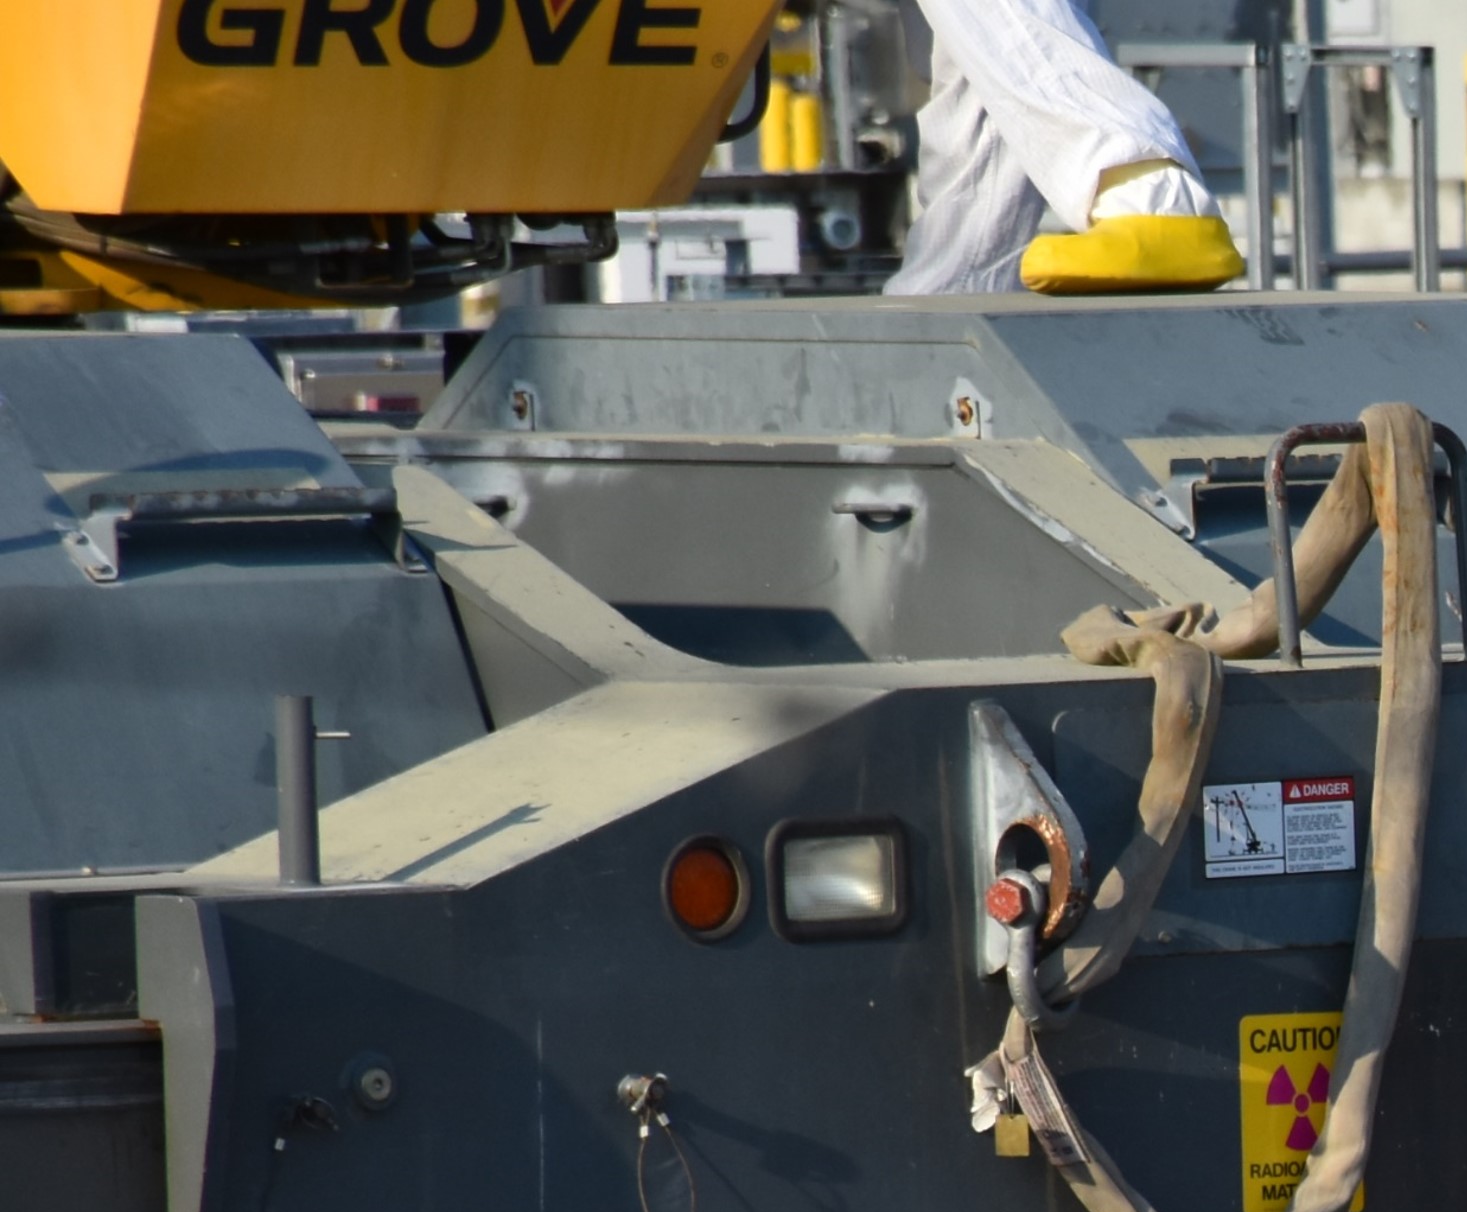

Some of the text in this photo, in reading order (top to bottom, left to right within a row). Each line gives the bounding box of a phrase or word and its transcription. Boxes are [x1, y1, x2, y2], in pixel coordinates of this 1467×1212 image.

[176, 0, 703, 67] GROVE
[1303, 782, 1349, 796] DANGER
[1250, 1026, 1340, 1054] CAUTIO
[1250, 1161, 1306, 1178] RADIO
